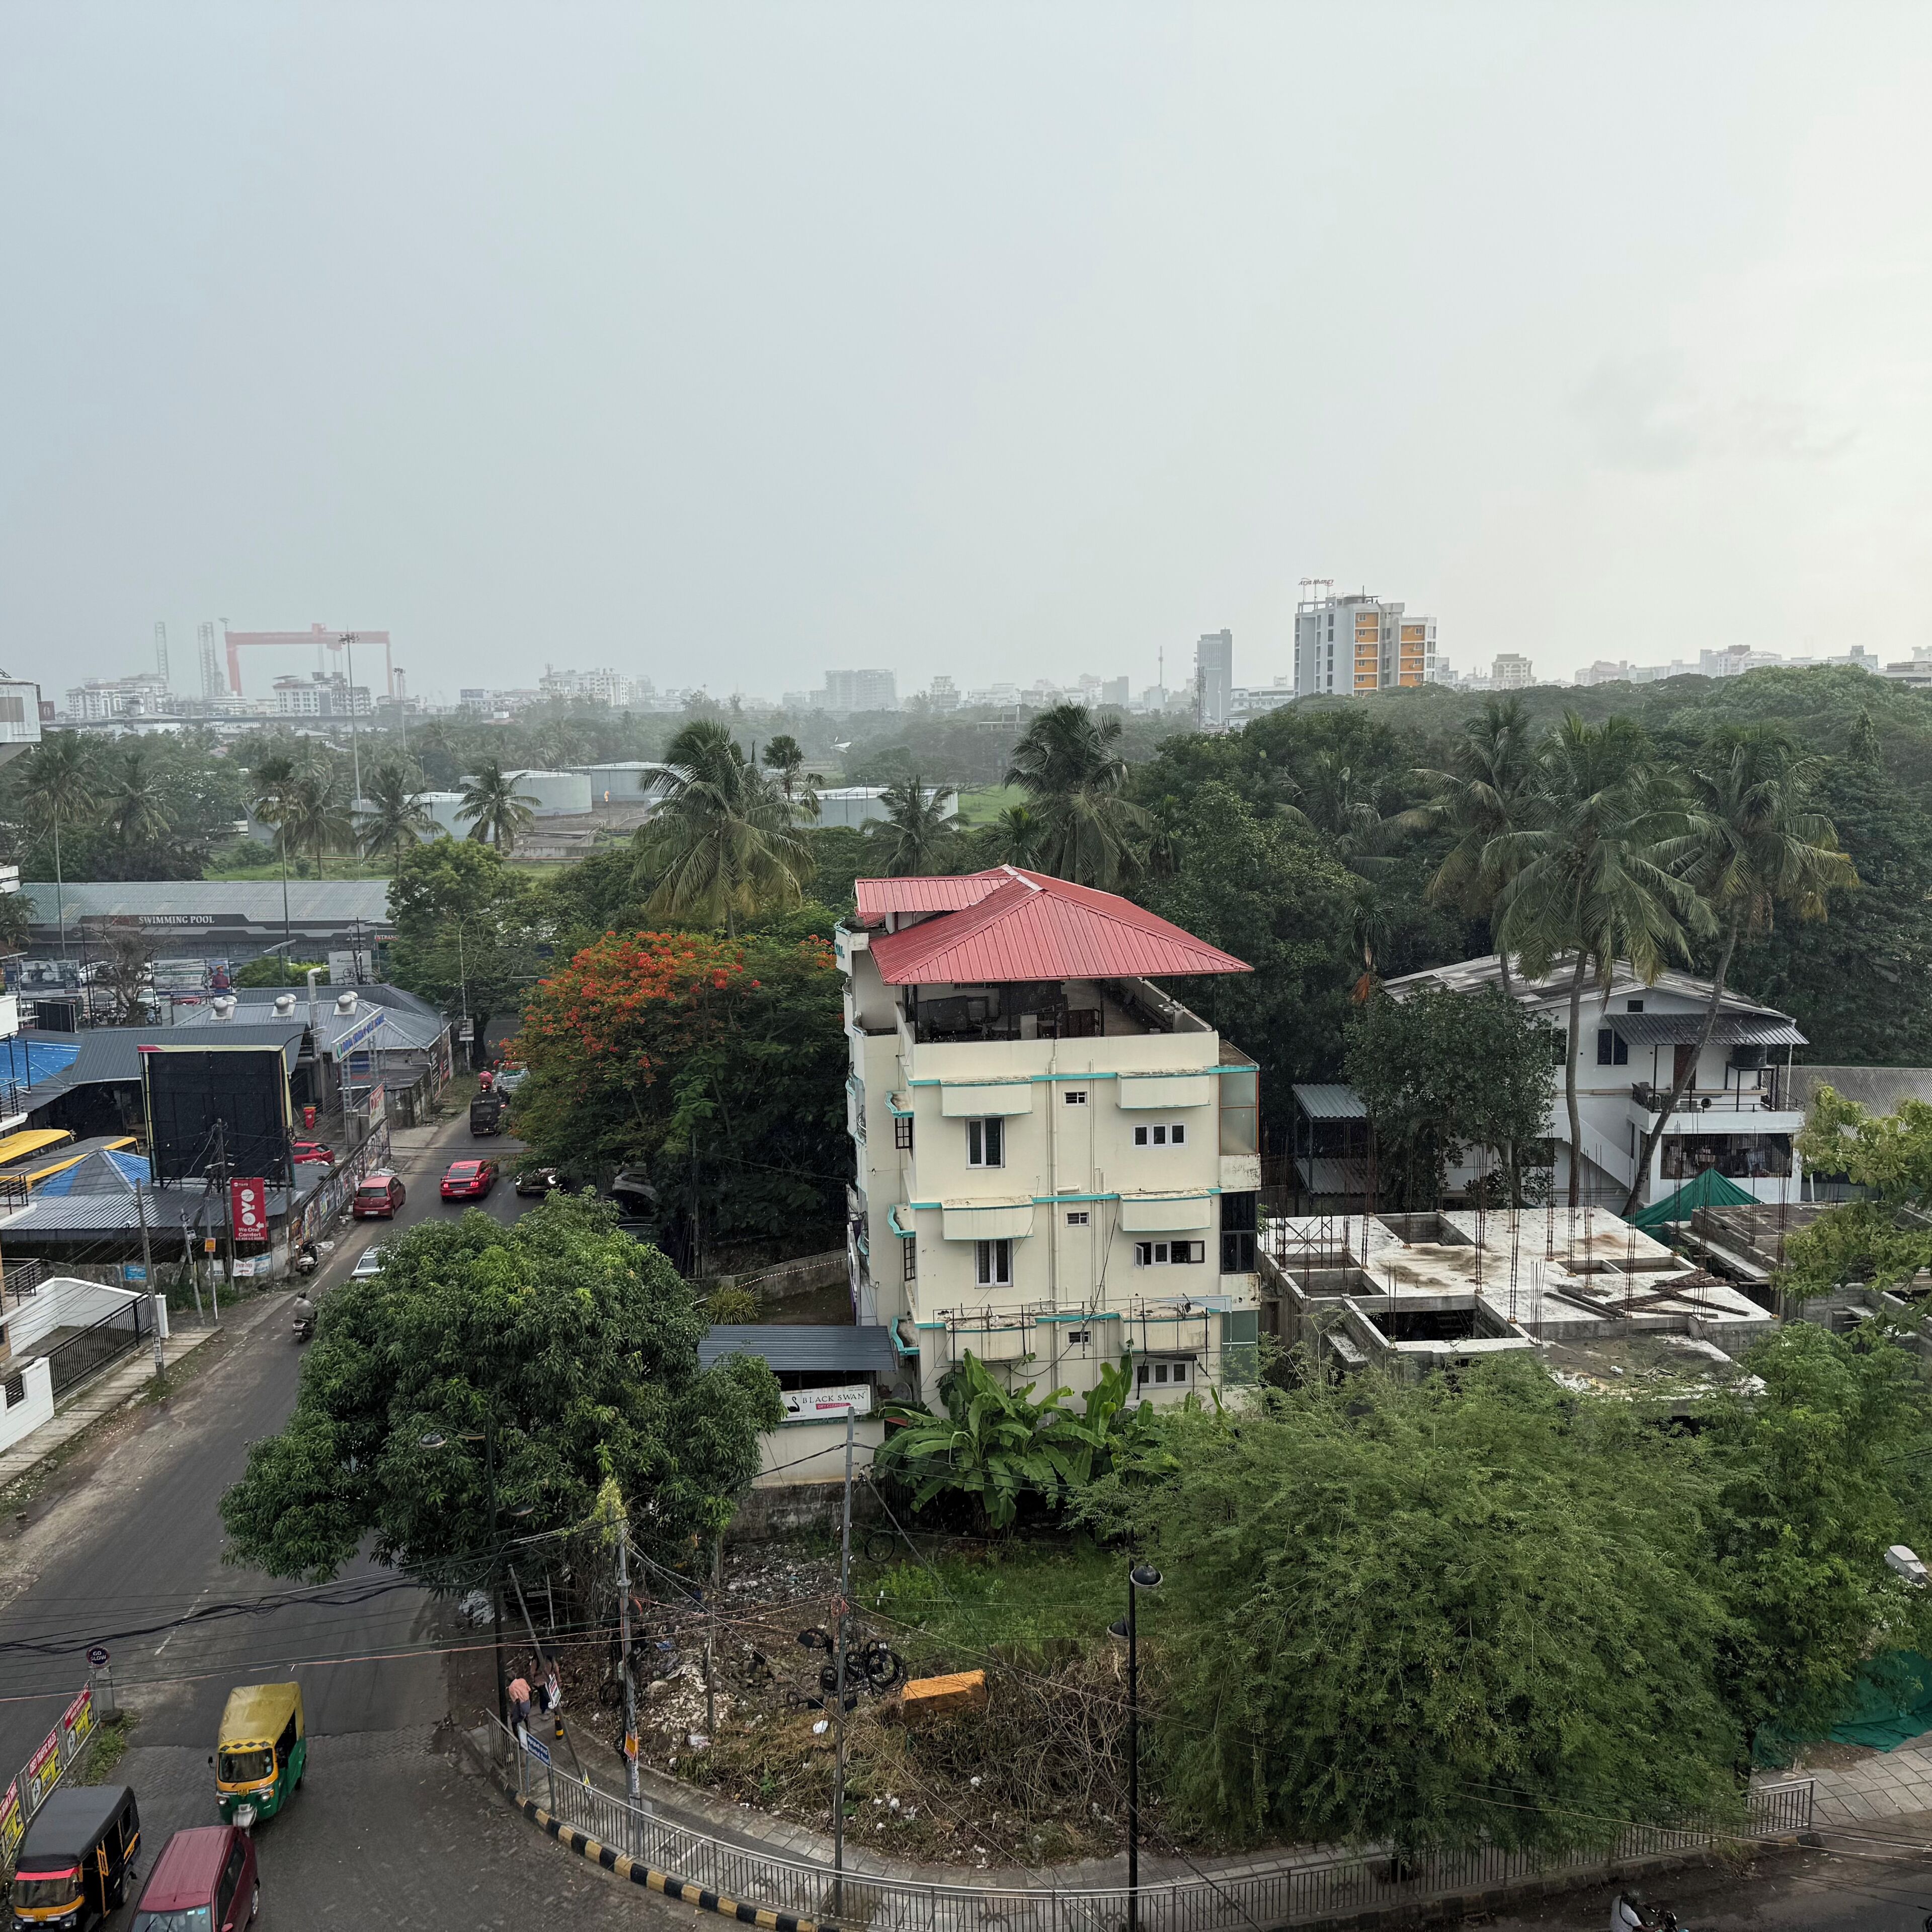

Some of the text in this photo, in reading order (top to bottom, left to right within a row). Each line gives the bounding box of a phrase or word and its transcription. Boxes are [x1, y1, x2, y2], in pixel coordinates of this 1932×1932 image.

[138, 916, 188, 924] SWIMMING
[241, 1189, 255, 1226] OYO
[802, 1392, 864, 1404] BLACK SWAN
